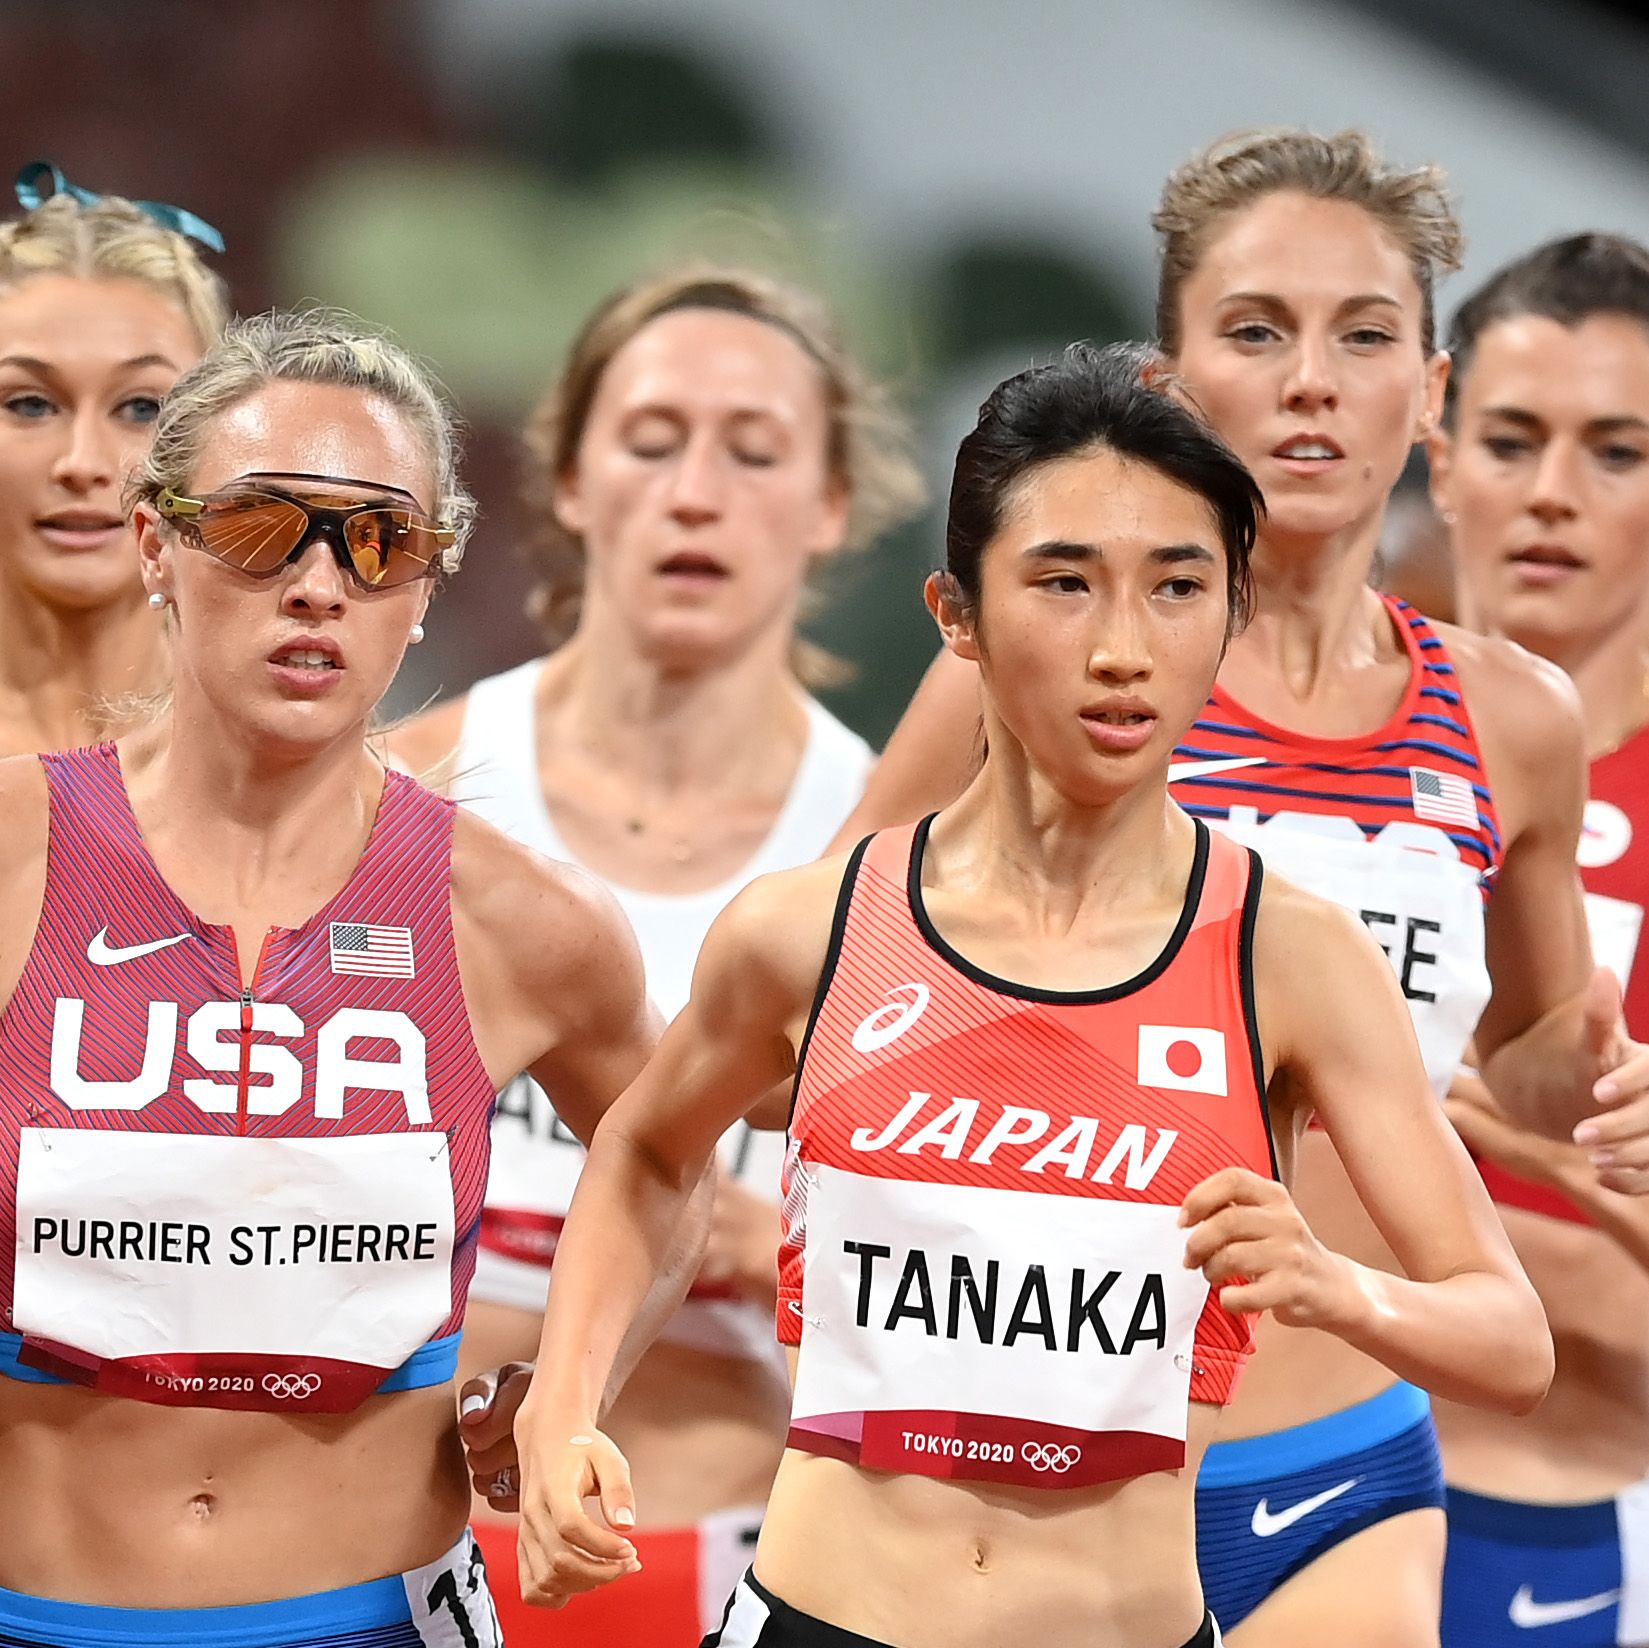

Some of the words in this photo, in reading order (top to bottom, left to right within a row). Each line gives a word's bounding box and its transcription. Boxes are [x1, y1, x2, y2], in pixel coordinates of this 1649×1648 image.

[50, 997, 433, 1126] USA
[850, 1091, 1179, 1191] JAPAN
[33, 1217, 212, 1265] PURRIER
[229, 1222, 438, 1266] ST.PIERRE
[843, 1240, 1167, 1356] TANAKA
[207, 1377, 254, 1391] 2020
[902, 1432, 964, 1458] TOKYO
[966, 1441, 1014, 1463] 2020
